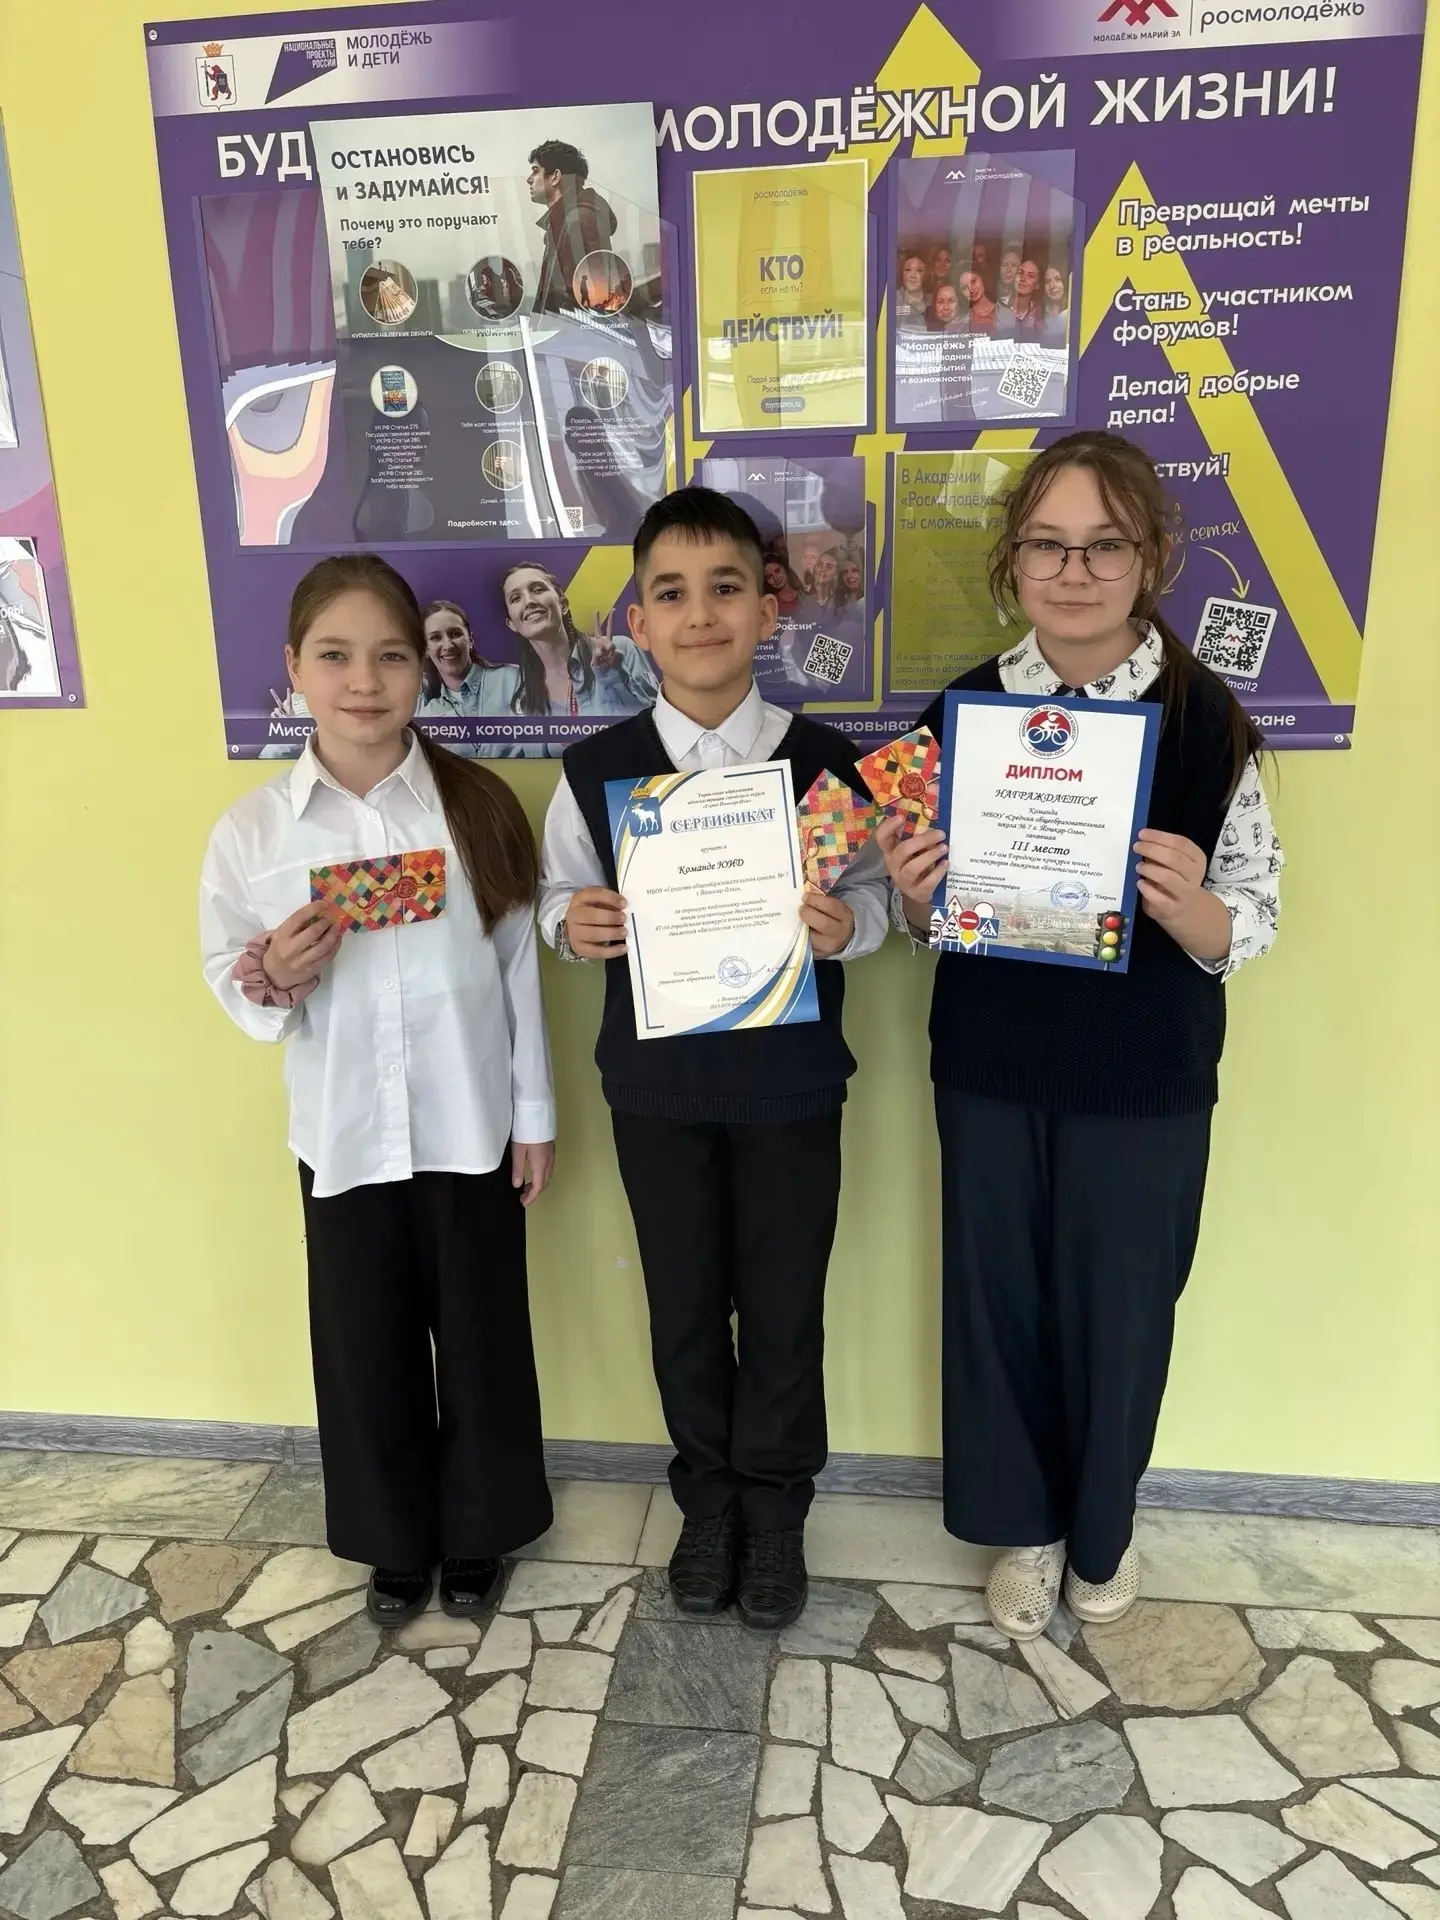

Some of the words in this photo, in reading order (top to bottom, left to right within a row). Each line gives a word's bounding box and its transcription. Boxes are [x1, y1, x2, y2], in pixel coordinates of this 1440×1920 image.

[1200, 0, 1365, 33] росмолодёжь
[346, 30, 433, 50] МОЛОДЁЖЬ
[1093, 32, 1138, 42] МОЛОДЁЖЬ
[1140, 30, 1169, 40] МАРИЙ
[283, 39, 335, 52] НАЦИОНАЛЬНЫЕ
[306, 49, 336, 60] ПРОЕКТЫ
[312, 59, 337, 69] РОССИИ
[348, 54, 358, 67] И
[362, 51, 400, 69] ДЕТИ
[217, 131, 313, 182] БУД
[654, 73, 1066, 153] МОЛОДЁЖНОЙ
[1089, 66, 1337, 126] ЖИЗНИ!
[331, 144, 475, 170] ОСТАНОВИСЬ
[336, 186, 348, 200] и
[354, 172, 490, 201] ЗАДУМАЙСЯ!
[753, 187, 809, 203] росмолодёжь
[1119, 195, 1275, 229] Превращай
[1288, 195, 1370, 216] мечты
[340, 217, 395, 233] Почему
[399, 217, 422, 229] это
[427, 213, 498, 230] поручают
[342, 237, 382, 250] тебе?
[1117, 238, 1133, 255] в
[1143, 222, 1303, 259] реальность!
[760, 254, 804, 282] КТО
[760, 286, 778, 294] если
[779, 283, 789, 292] не
[790, 281, 804, 293] ты?
[1115, 288, 1190, 312] Стань
[1200, 284, 1354, 315] участником
[721, 308, 844, 348] ДЕЙСТВУЙ!
[901, 333, 959, 341] Информационная
[1112, 313, 1239, 346] форумов!
[901, 341, 966, 351] "Молодёжь
[908, 376, 973, 384] возможностей
[1108, 372, 1190, 401] Делай
[1199, 369, 1300, 398] добрые
[1107, 401, 1176, 429] дела!
[1153, 452, 1230, 481] ствуй!
[902, 469, 910, 484] В
[914, 469, 981, 486] Академии
[447, 519, 497, 528] Подробности
[900, 518, 916, 529] ты
[920, 516, 982, 530] сможешь
[1189, 520, 1241, 542] сетях
[268, 722, 319, 737] Мисси
[421, 724, 471, 739] среду,
[475, 724, 544, 739] которая
[549, 724, 609, 736] помога
[1250, 713, 1296, 728] ране
[1005, 763, 1084, 783] ДИПЛОМ
[994, 788, 1099, 806] НАГРАЖДАЕТСЯ
[670, 808, 777, 833] СЕРТИФИКАТ
[981, 811, 1006, 820] МБОУ
[1005, 814, 1035, 823] «Средняя
[1034, 816, 1106, 829] общеобразовательная
[1028, 807, 1059, 816] Команда
[1010, 840, 1031, 852] III
[1031, 845, 1071, 857] место
[677, 861, 716, 876] Команде
[716, 858, 745, 870] ЮИД
[969, 857, 1009, 868] инспекторов
[1009, 860, 1040, 870] движения
[1008, 852, 1042, 863] Городском
[1042, 857, 1071, 867] конкурсе
